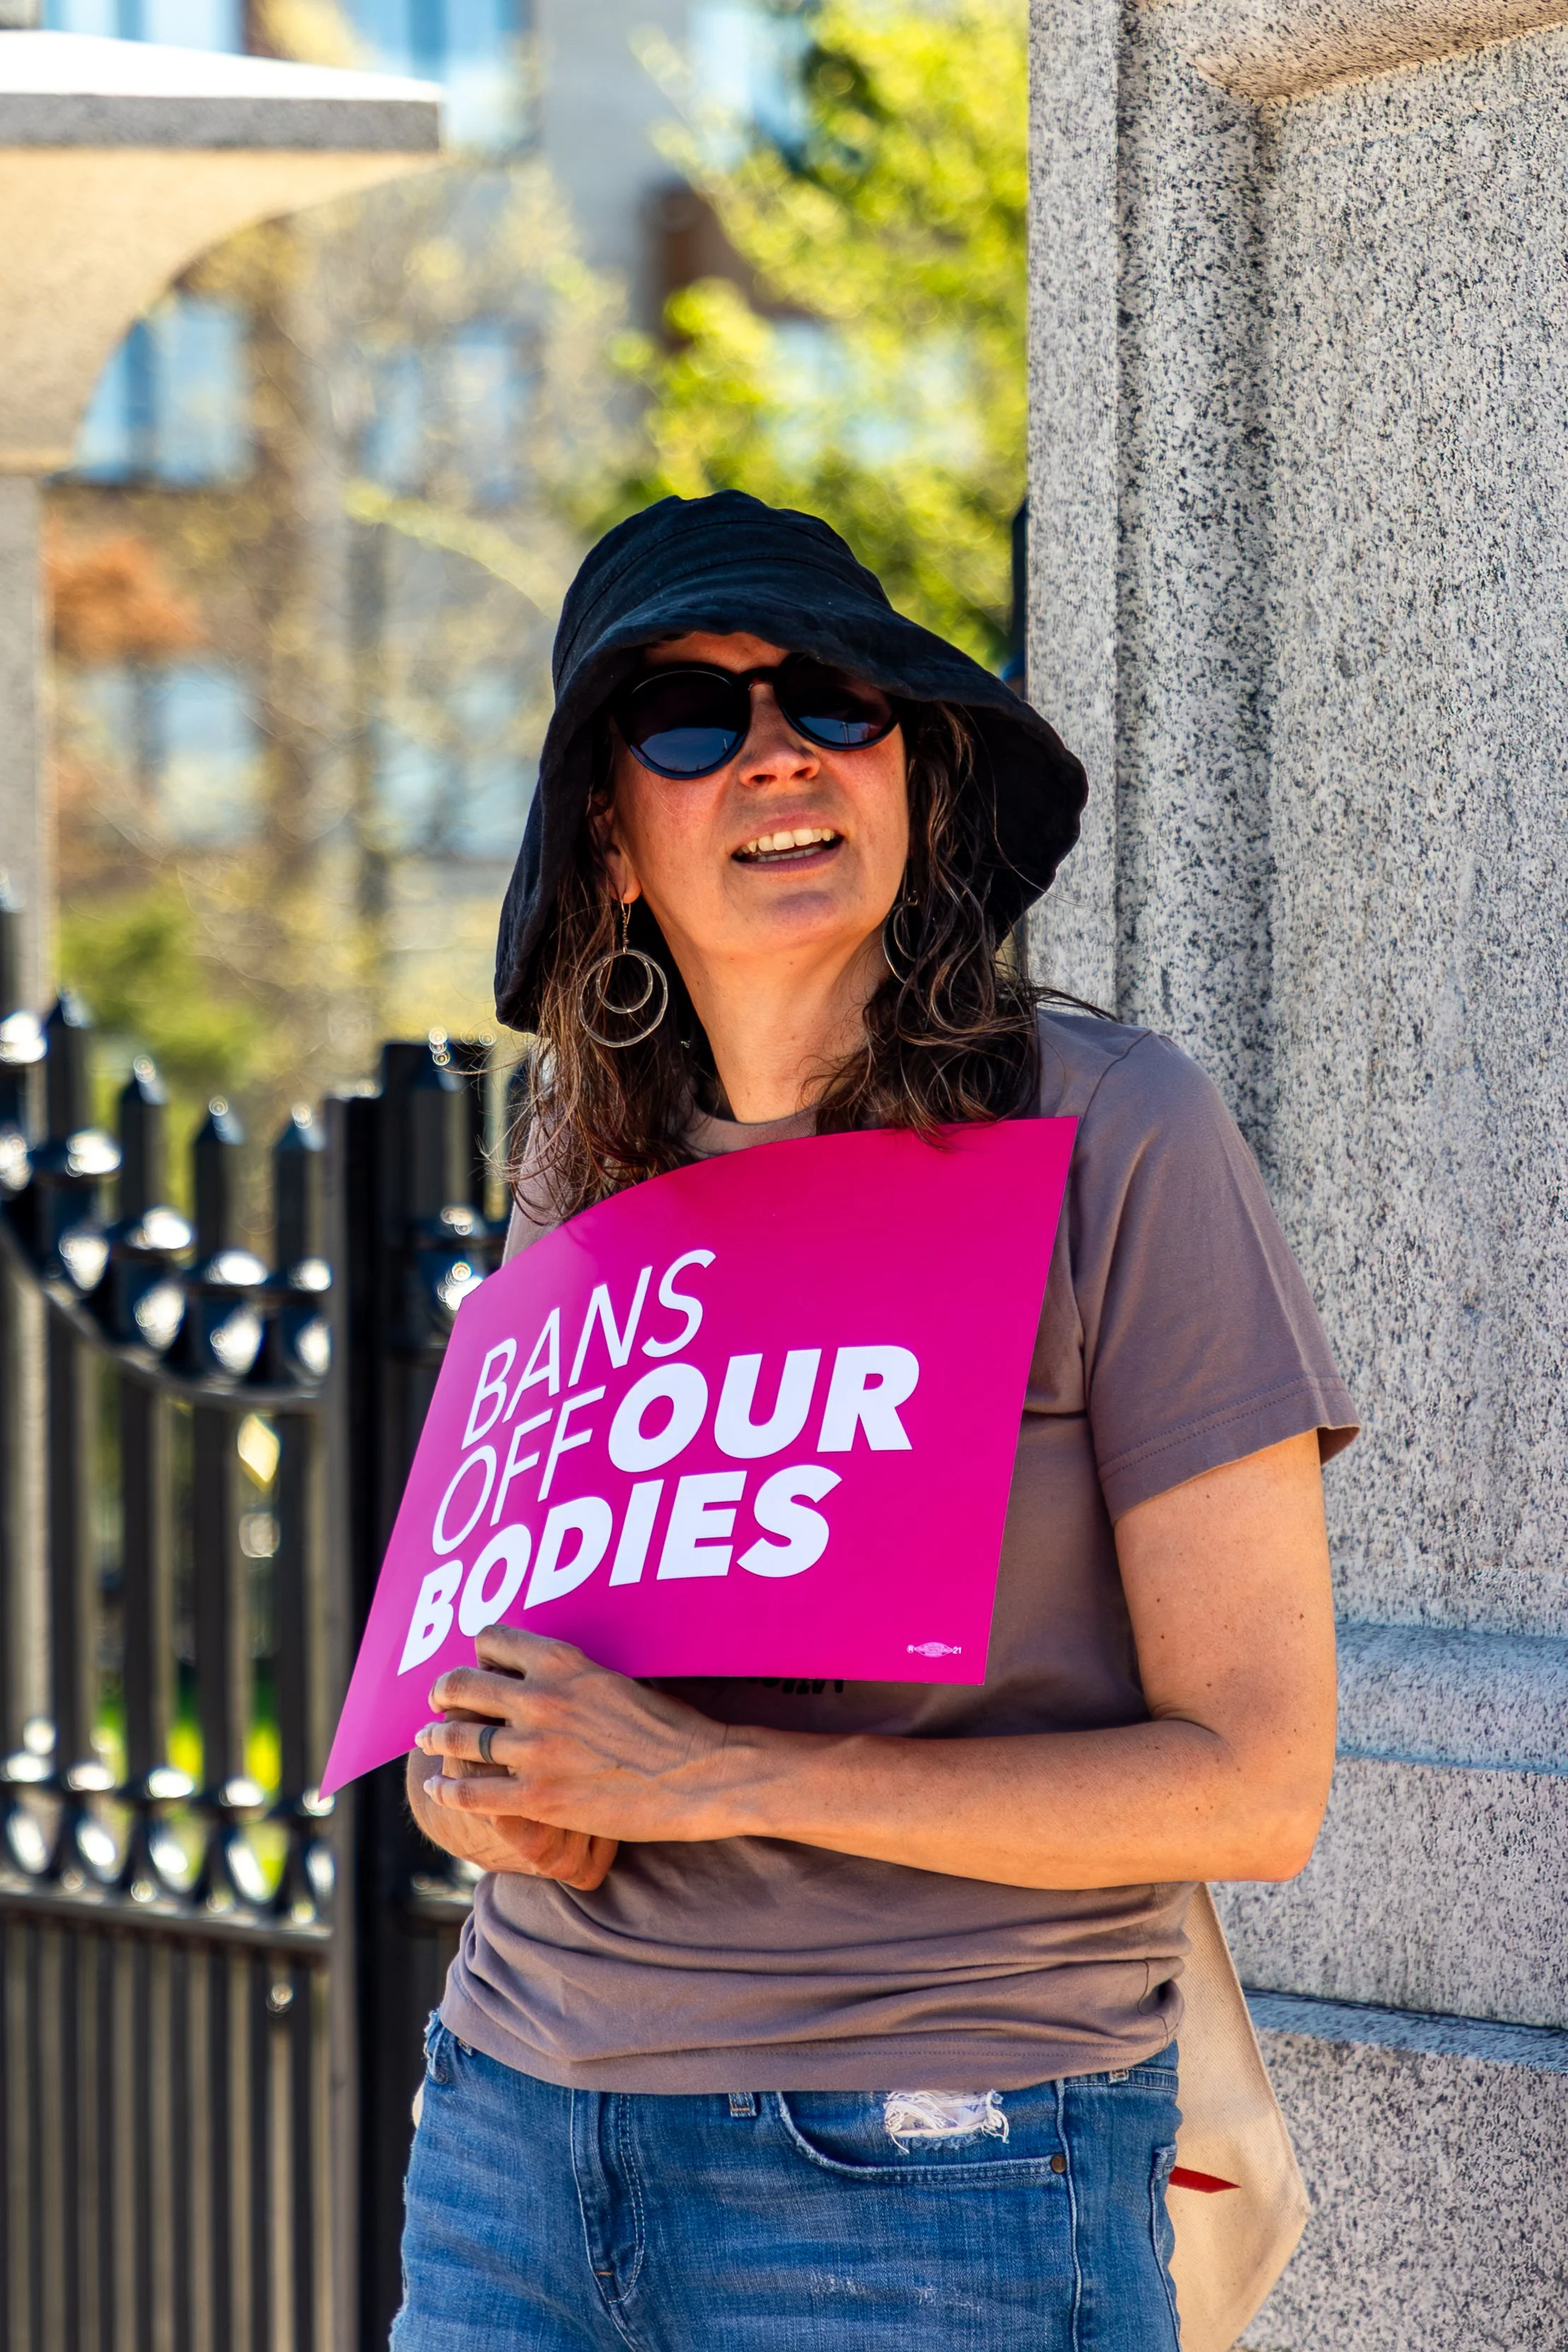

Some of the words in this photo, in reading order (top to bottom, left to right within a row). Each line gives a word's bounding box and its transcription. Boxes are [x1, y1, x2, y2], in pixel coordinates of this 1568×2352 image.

[432, 1385, 606, 1556] OFF
[608, 1345, 919, 1473] OUR
[461, 1249, 716, 1450] BANS
[396, 1464, 842, 1676] BODIES
